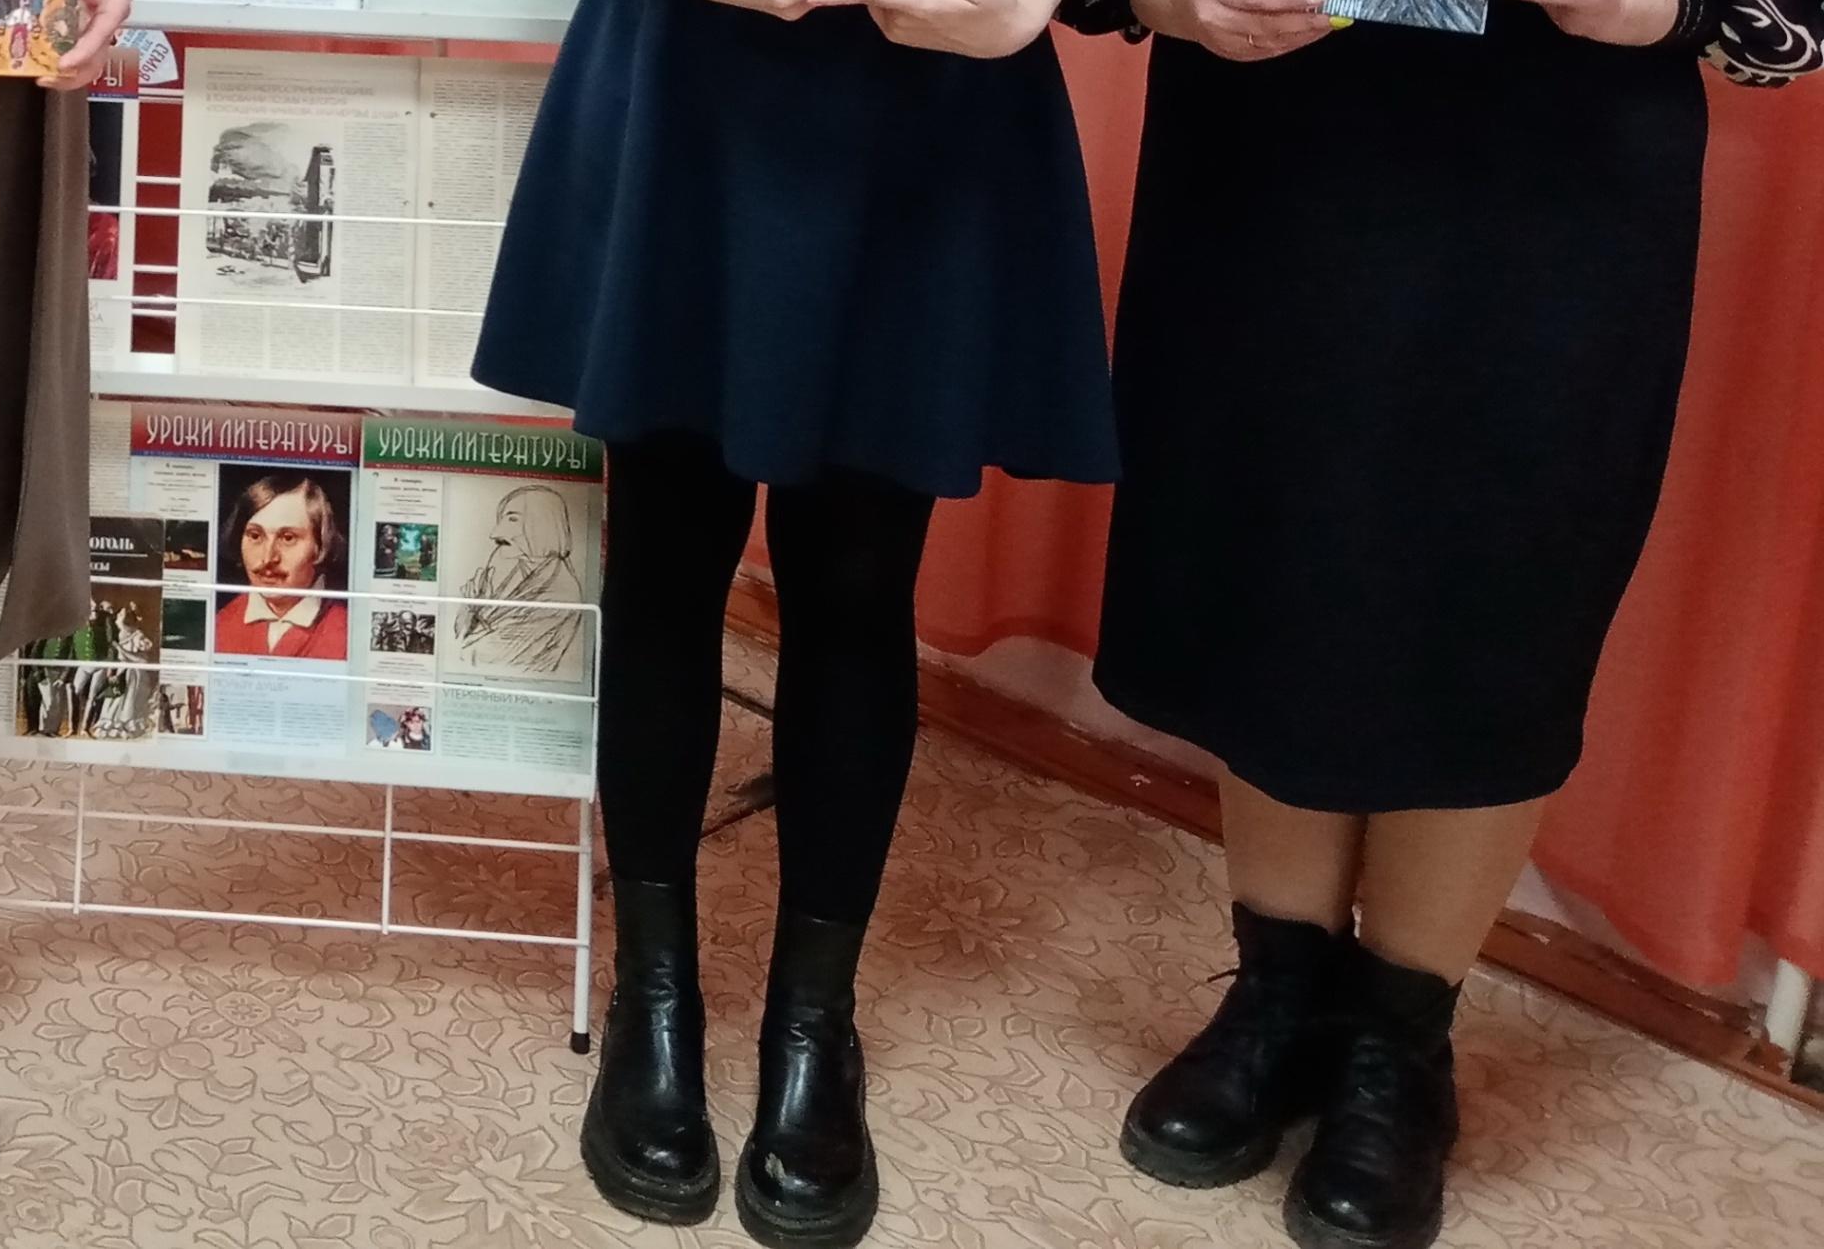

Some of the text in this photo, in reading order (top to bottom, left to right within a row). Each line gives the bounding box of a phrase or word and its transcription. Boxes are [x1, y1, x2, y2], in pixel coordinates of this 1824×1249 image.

[147, 415, 353, 455] УРОКИ ЛИТЕРАТУРЫ
[379, 427, 587, 470] УРОКИ ЛИТЕРАТУРЫ
